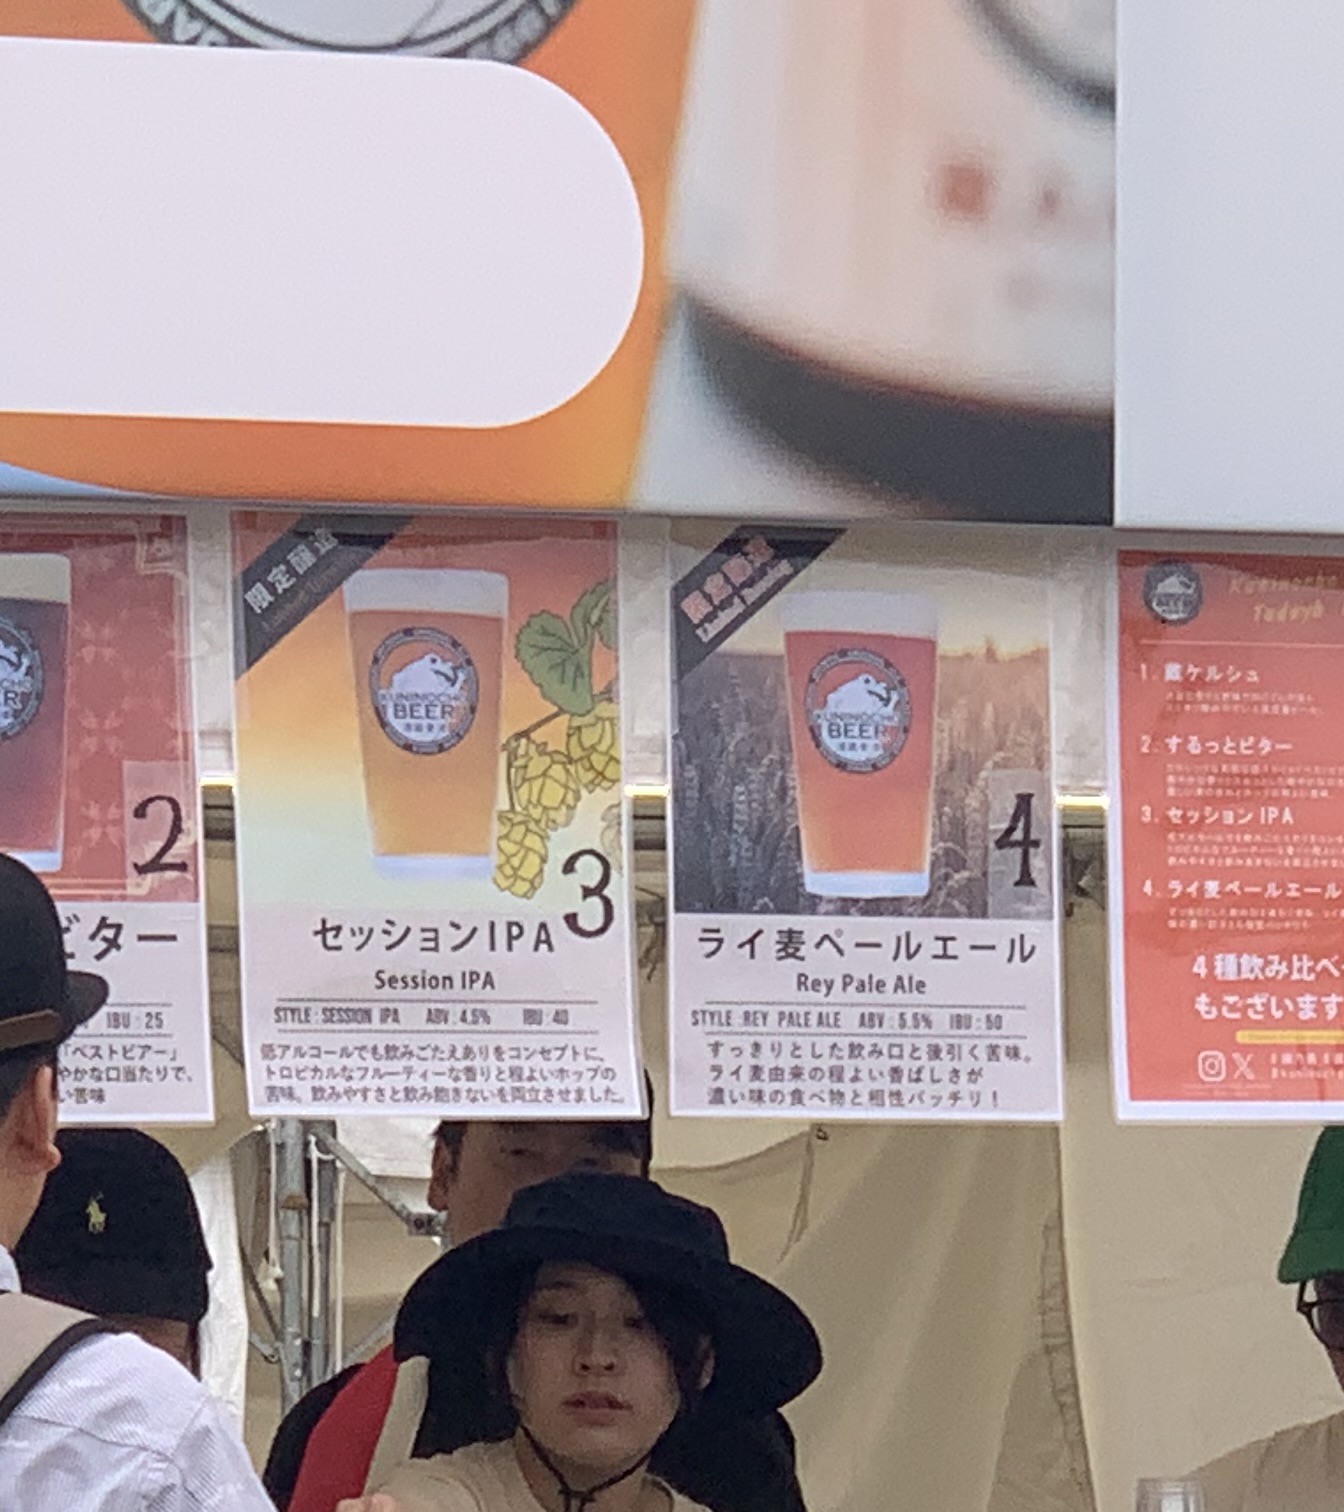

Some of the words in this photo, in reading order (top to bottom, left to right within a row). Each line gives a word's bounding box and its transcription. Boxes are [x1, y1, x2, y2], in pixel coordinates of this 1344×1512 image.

[393, 703, 456, 721] BEER
[132, 795, 188, 875] 2
[995, 793, 1040, 887] 4
[562, 849, 615, 938] 3
[312, 917, 555, 953] セッションIPA
[697, 928, 1036, 964] ライ麦ペールエール
[374, 970, 454, 991] Session
[461, 971, 496, 991] IPA
[796, 974, 834, 996] Rey
[842, 974, 886, 995] Pale
[893, 975, 927, 995] Ale
[145, 1012, 164, 1029] 25
[1194, 993, 1344, 1020] もございます
